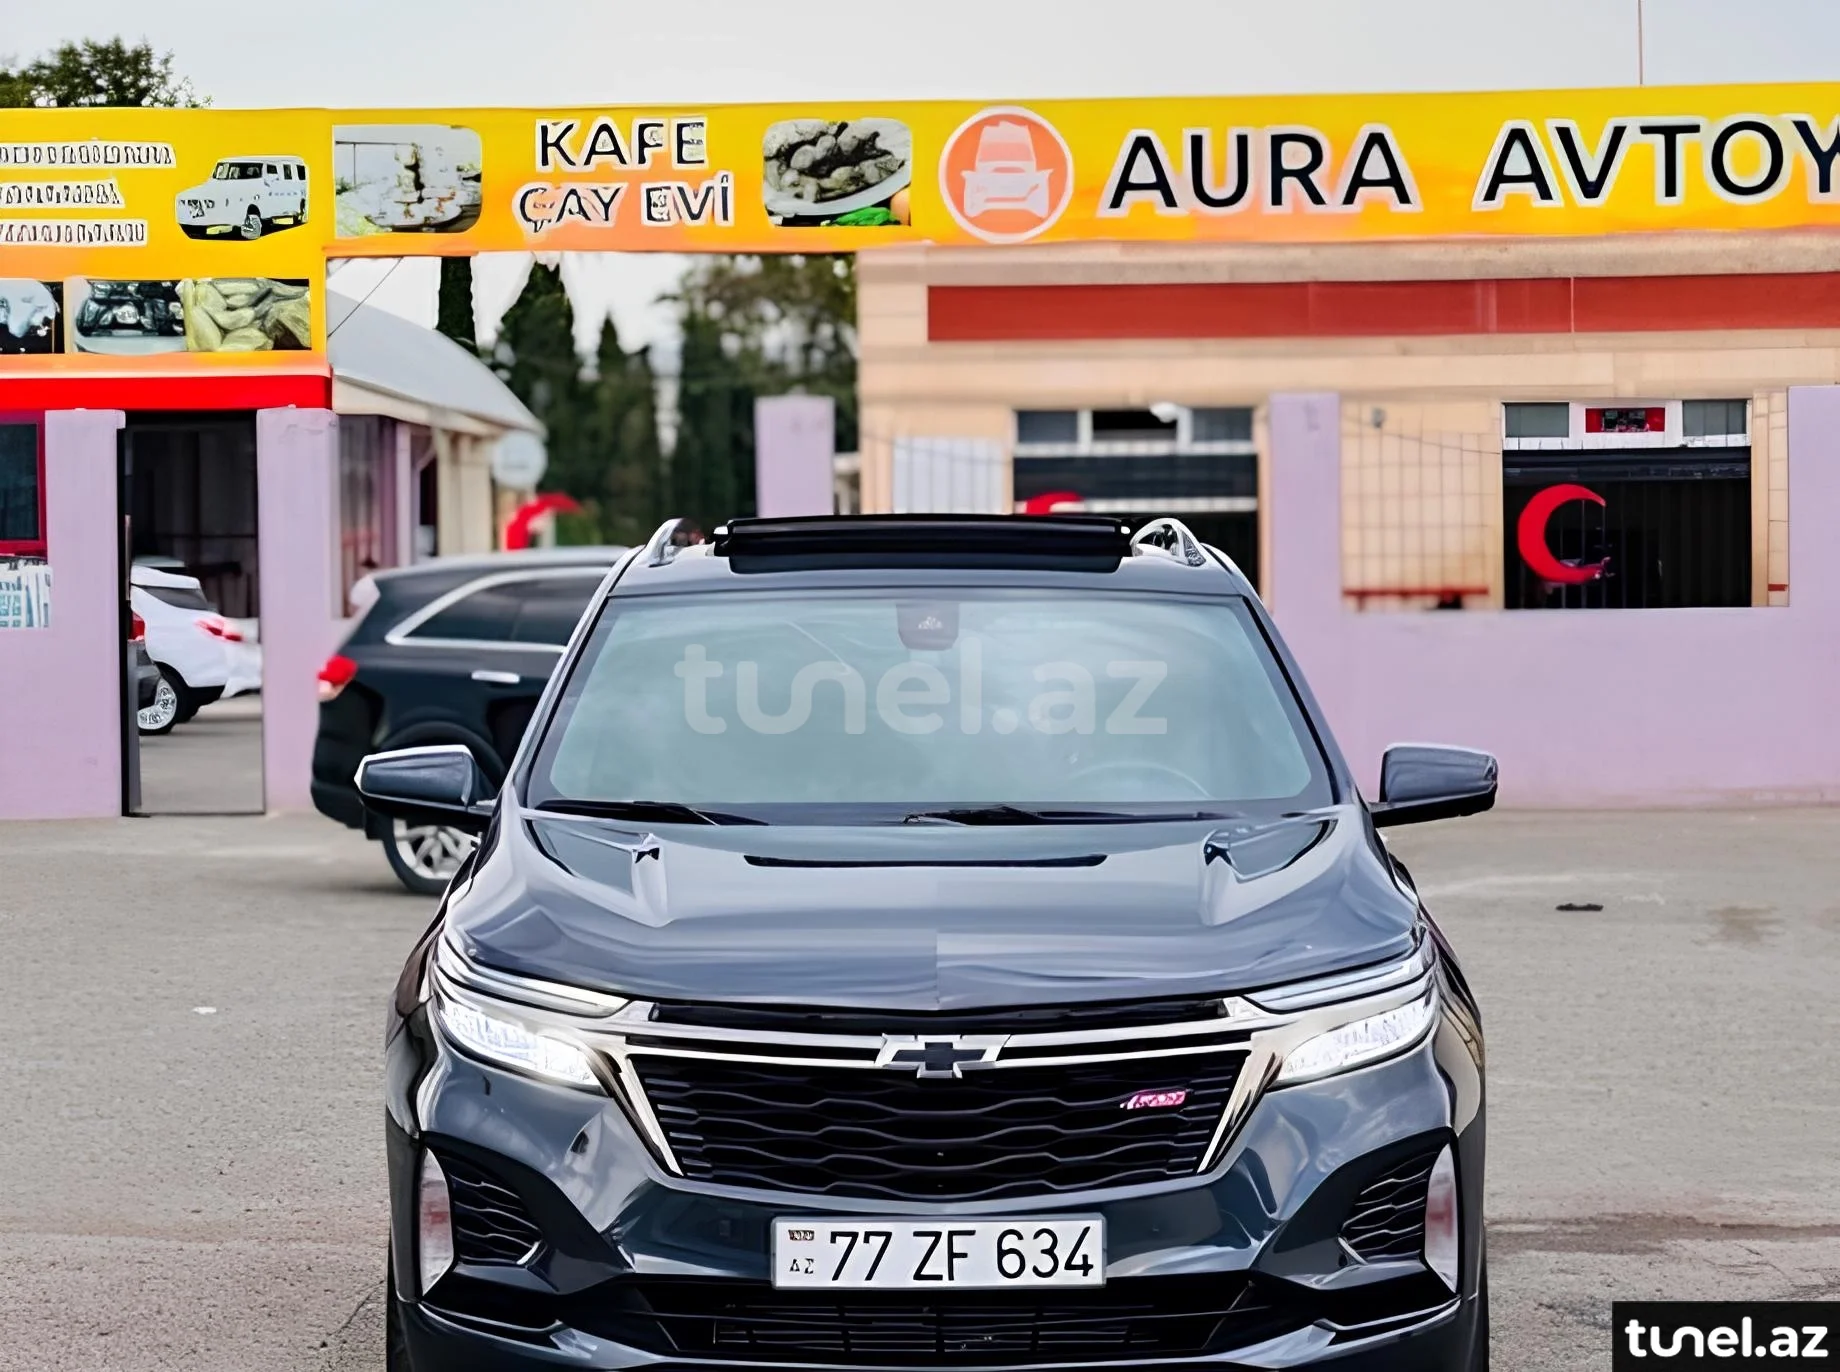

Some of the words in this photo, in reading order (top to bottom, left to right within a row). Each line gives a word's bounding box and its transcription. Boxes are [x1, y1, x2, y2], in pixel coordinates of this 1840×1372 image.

[540, 121, 706, 167] KAFE
[1109, 131, 1413, 209] AURA
[519, 187, 622, 232] ÇAY
[830, 1231, 893, 1281] 77
[912, 1230, 976, 1281] ZF
[996, 1226, 1094, 1279] 634
